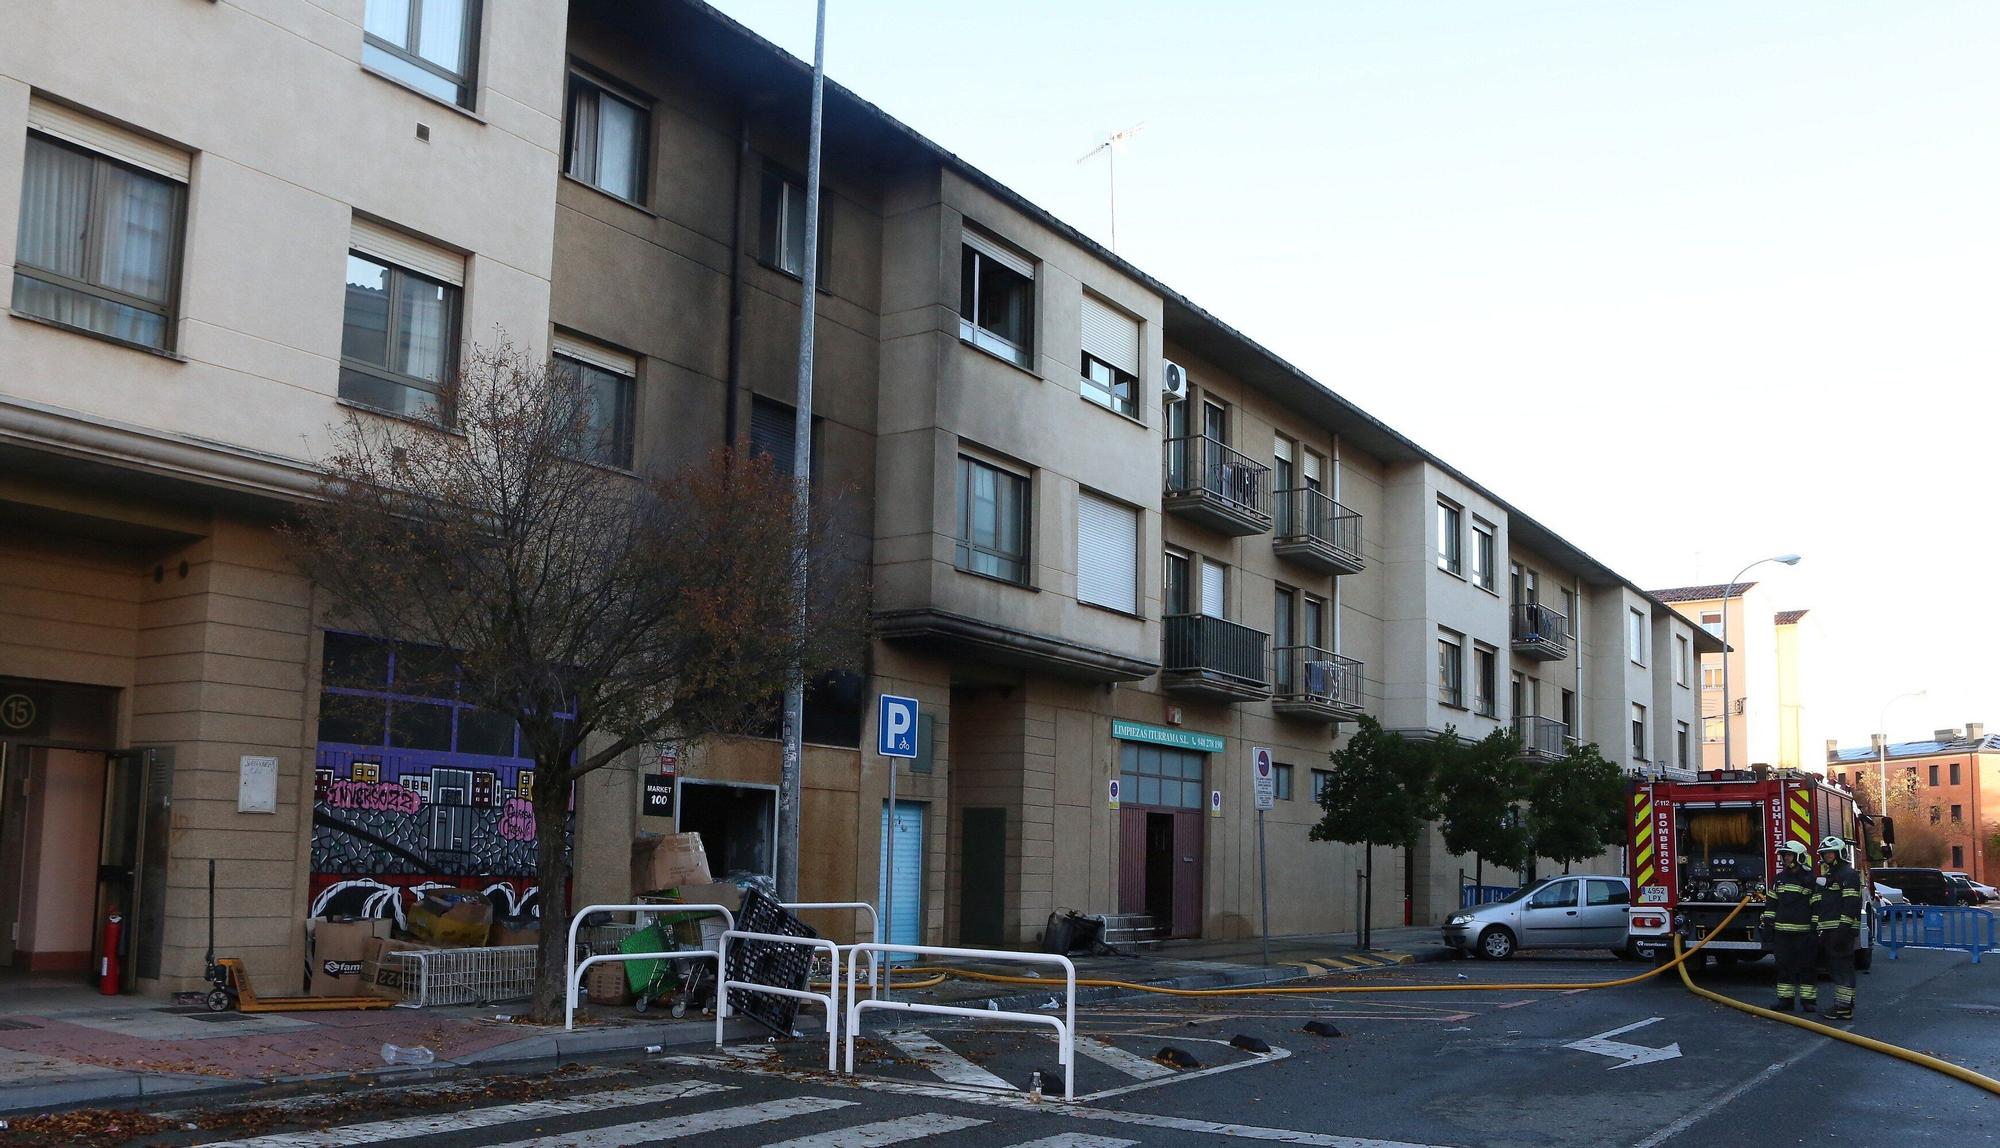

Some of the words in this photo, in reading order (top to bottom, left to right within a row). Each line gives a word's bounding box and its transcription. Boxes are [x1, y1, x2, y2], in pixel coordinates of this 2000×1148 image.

[9, 701, 27, 722] 15
[887, 703, 911, 749] P
[1114, 725, 1147, 739] LIMPIEZAS
[1148, 730, 1179, 743] ITURRAMA
[647, 785, 672, 794] MARKET
[651, 794, 668, 805] 100
[1658, 813, 1670, 873] BOMBEROS
